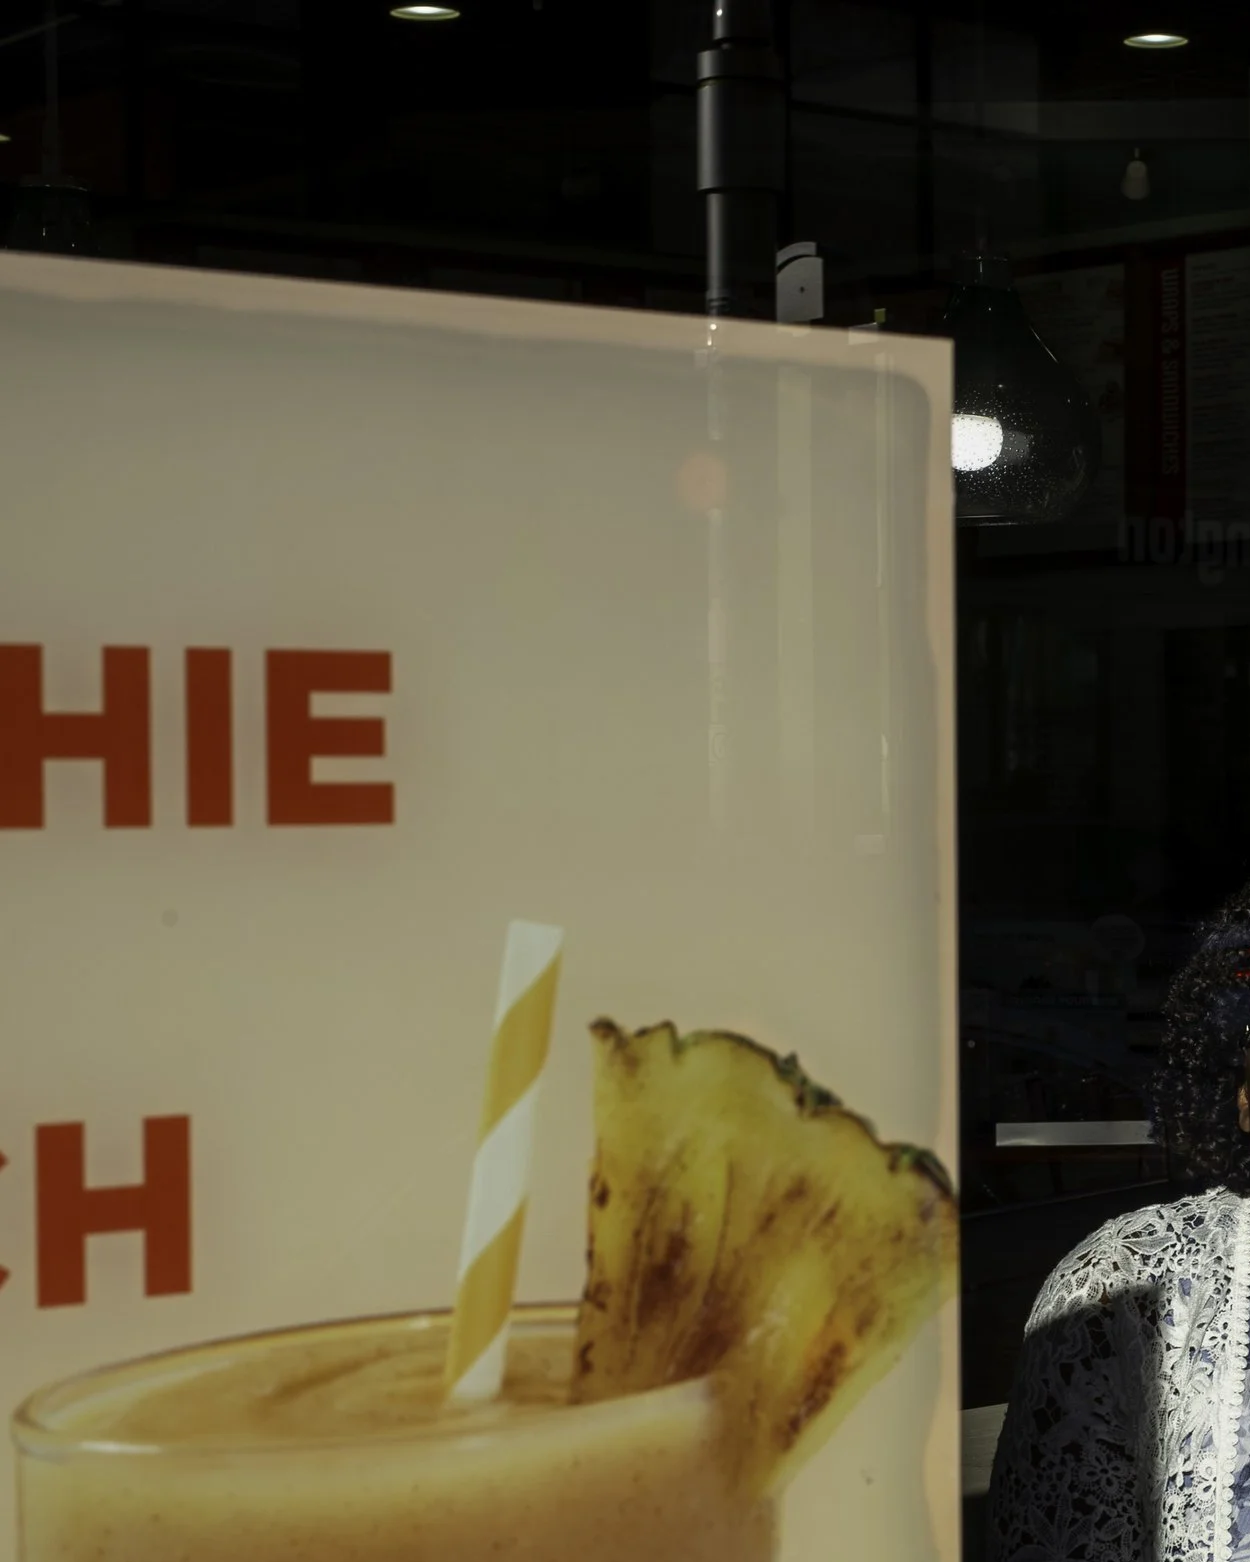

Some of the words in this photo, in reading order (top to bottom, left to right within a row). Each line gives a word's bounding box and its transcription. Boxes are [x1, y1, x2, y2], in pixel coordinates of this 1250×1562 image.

[1160, 268, 1180, 333] WRAPS
[1160, 338, 1180, 354] &
[1160, 358, 1180, 475] SANDWICHES
[0, 645, 394, 828] HIE
[0, 1115, 190, 1308] H
